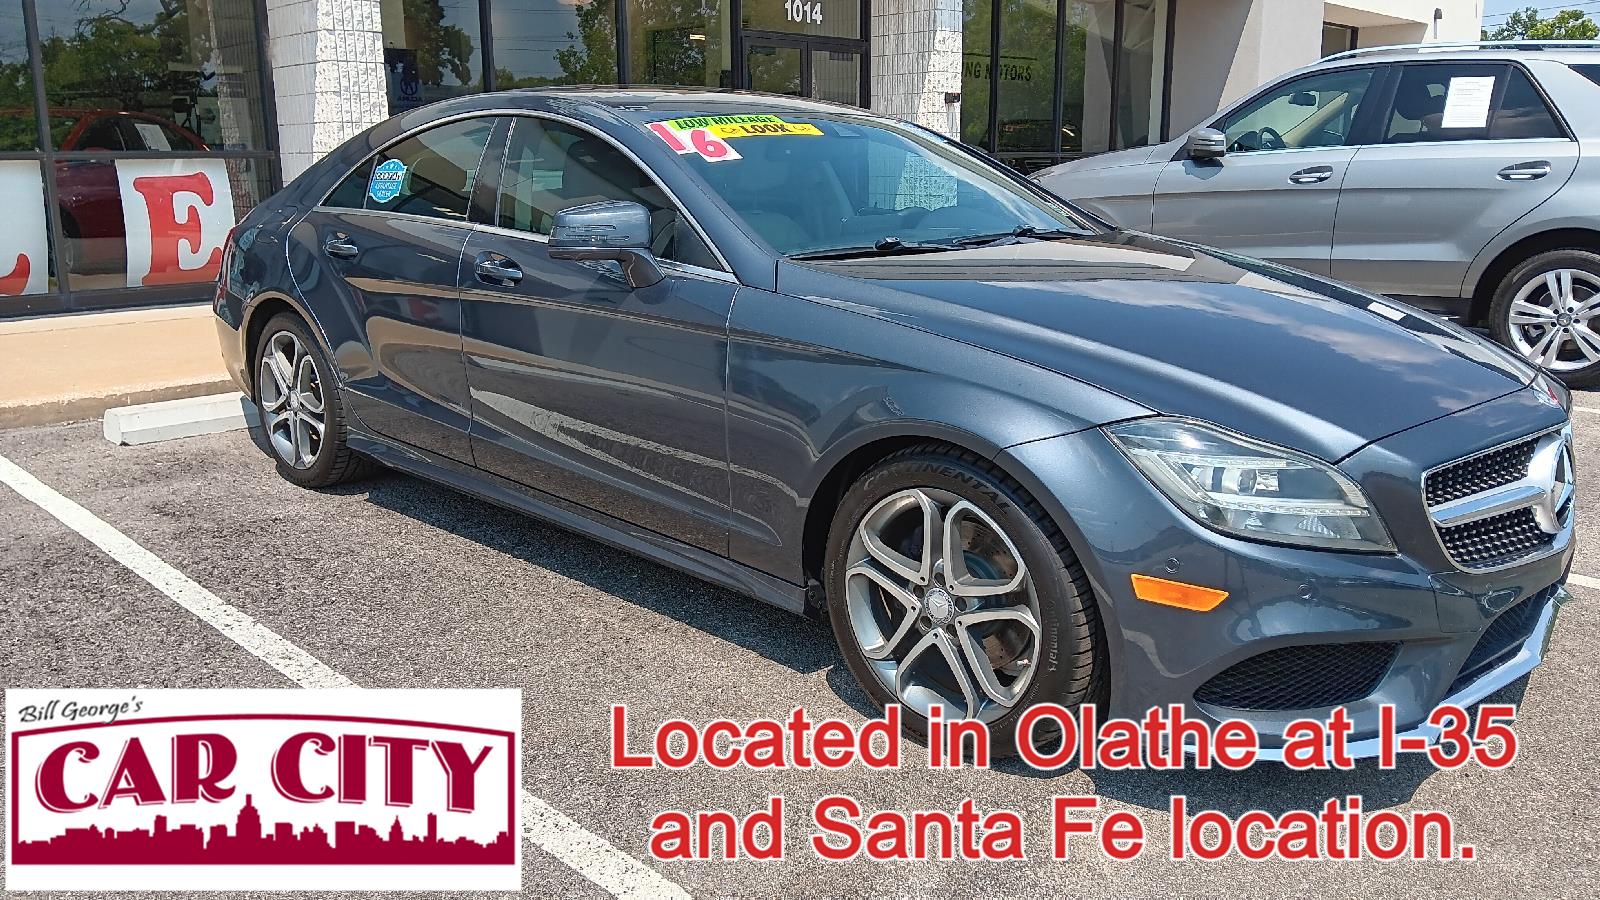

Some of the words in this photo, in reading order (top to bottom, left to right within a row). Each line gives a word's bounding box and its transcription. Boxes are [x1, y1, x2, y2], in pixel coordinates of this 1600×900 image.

[784, 0, 823, 25] 1014
[674, 118, 710, 131] LOW
[712, 115, 776, 126] MILEAGE
[738, 122, 794, 134] LOOK
[133, 171, 223, 287] E
